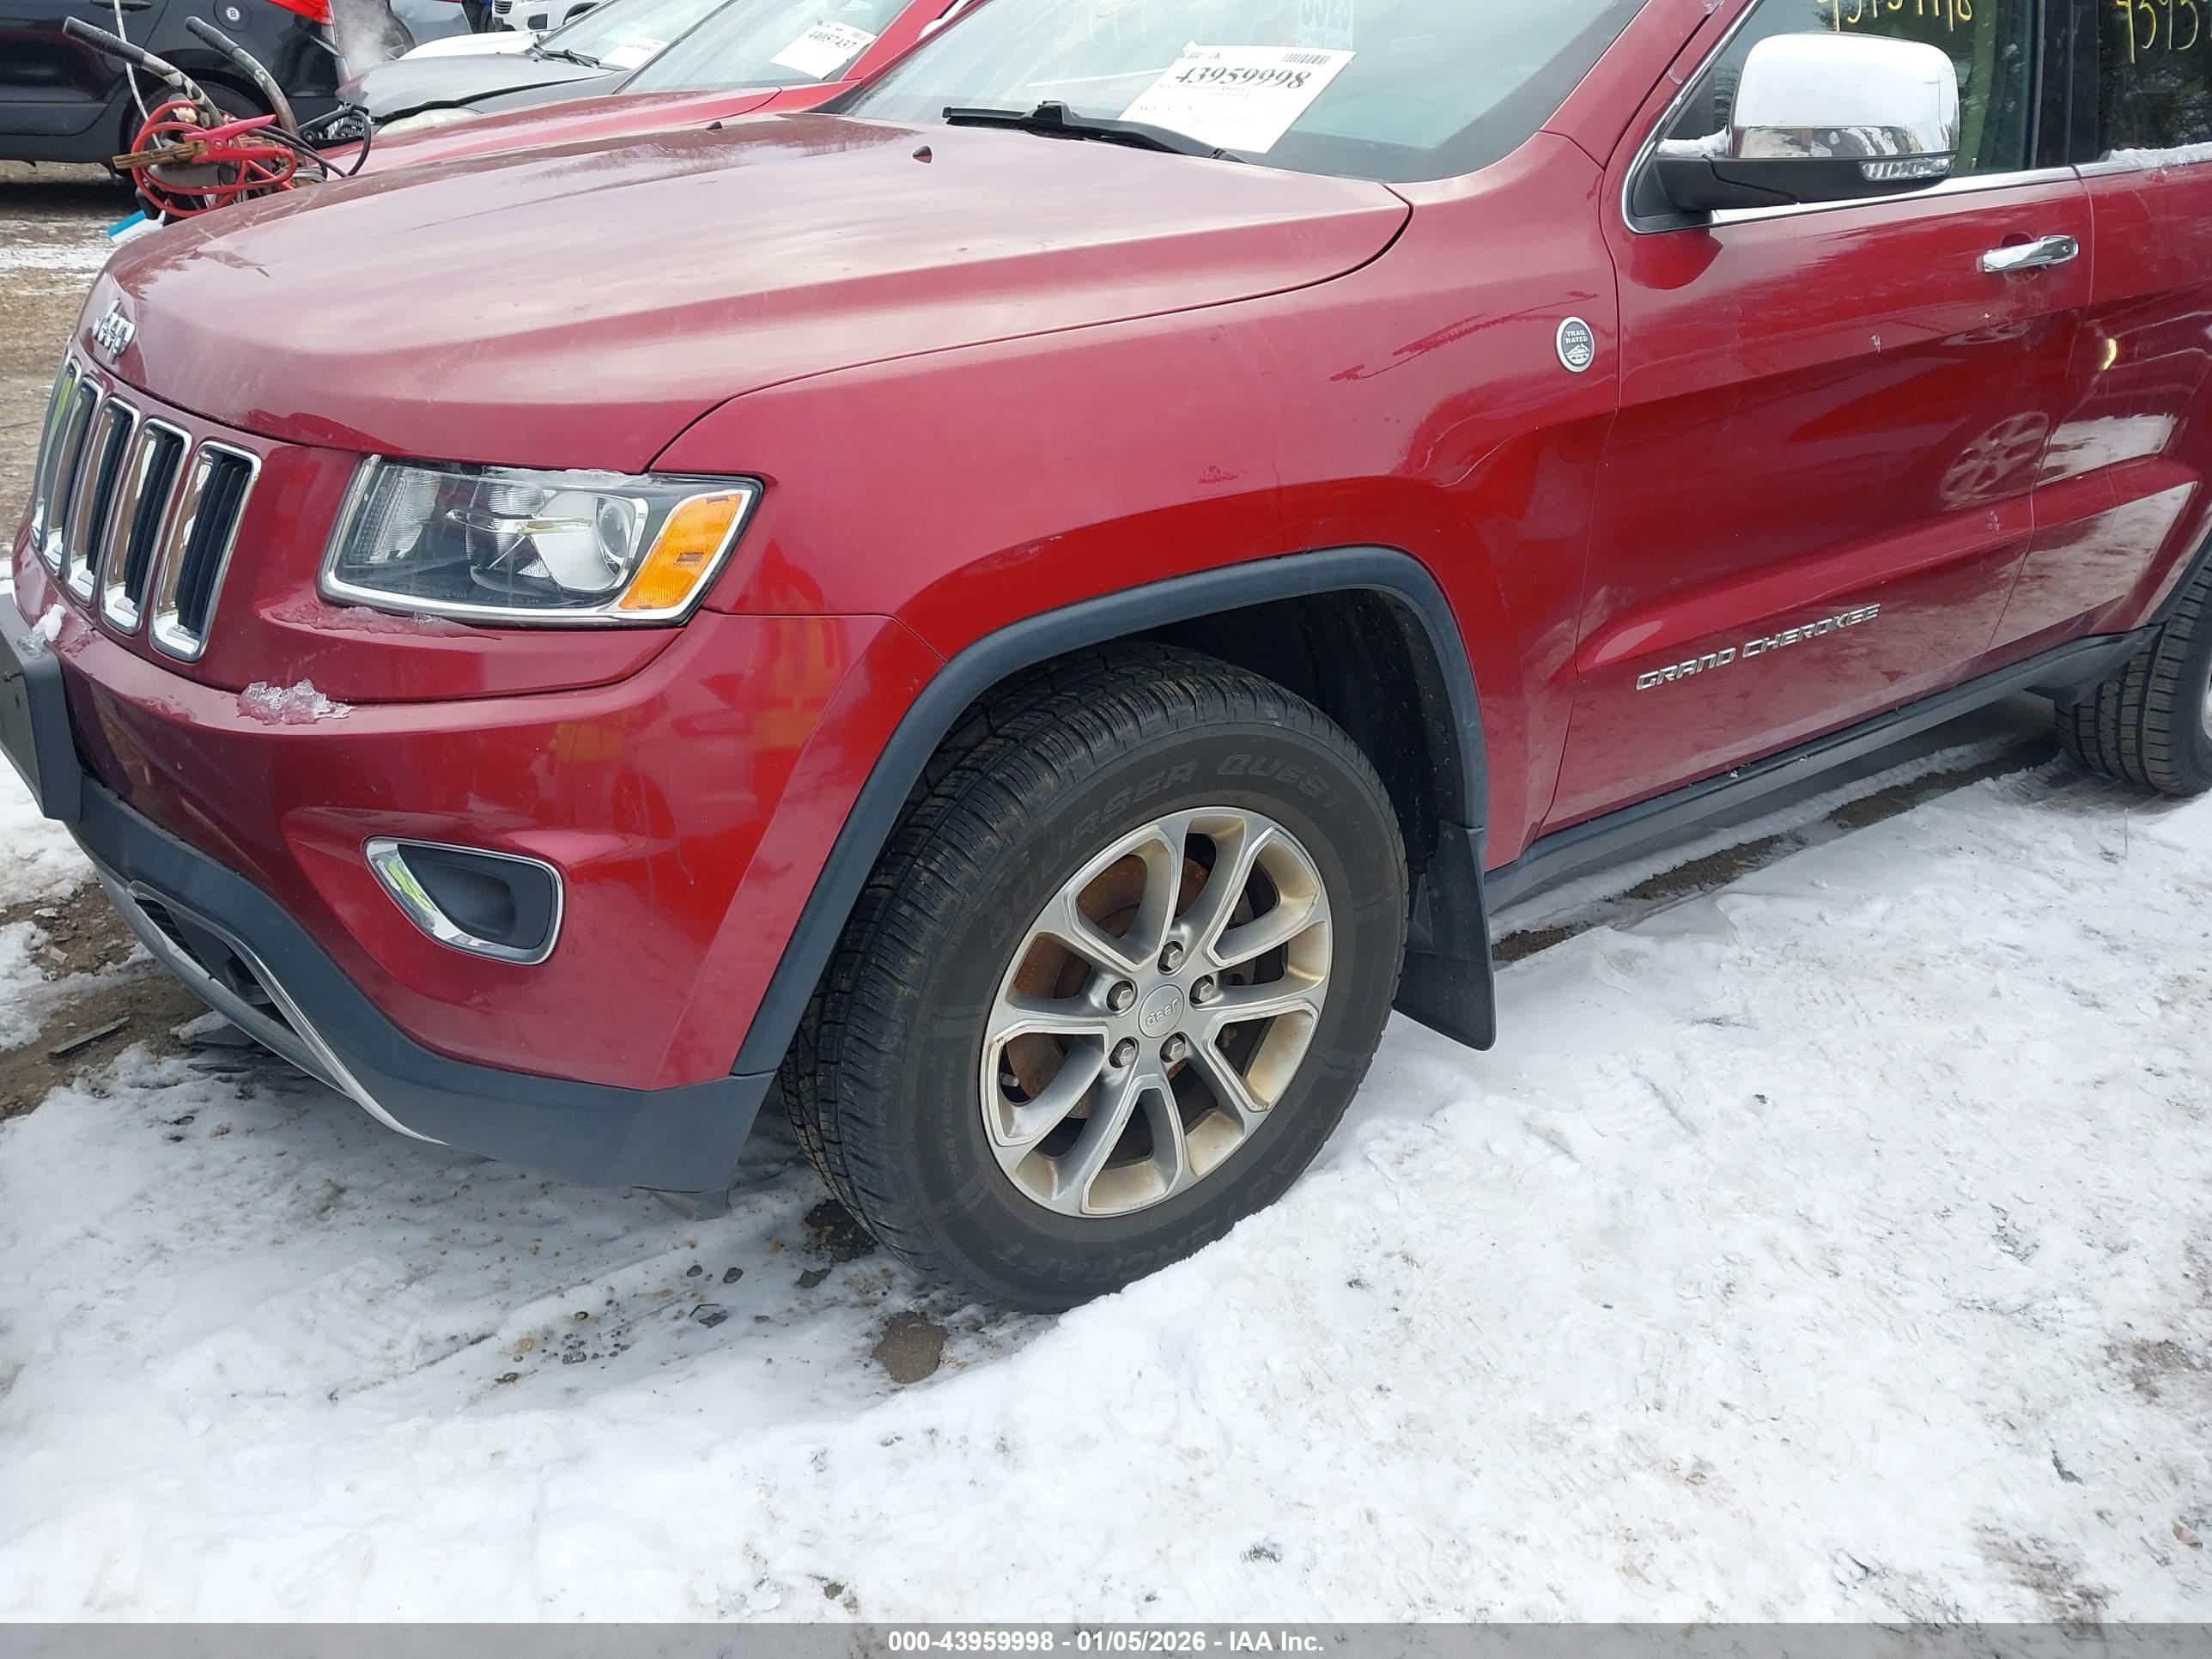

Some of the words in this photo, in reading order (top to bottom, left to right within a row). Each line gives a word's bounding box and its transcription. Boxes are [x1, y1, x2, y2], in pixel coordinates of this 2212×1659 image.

[1175, 65, 1313, 89] 43959998
[1565, 336, 1589, 344] RATED
[1635, 647, 1737, 690] GRAND
[1742, 603, 1881, 658] CHEROKEE
